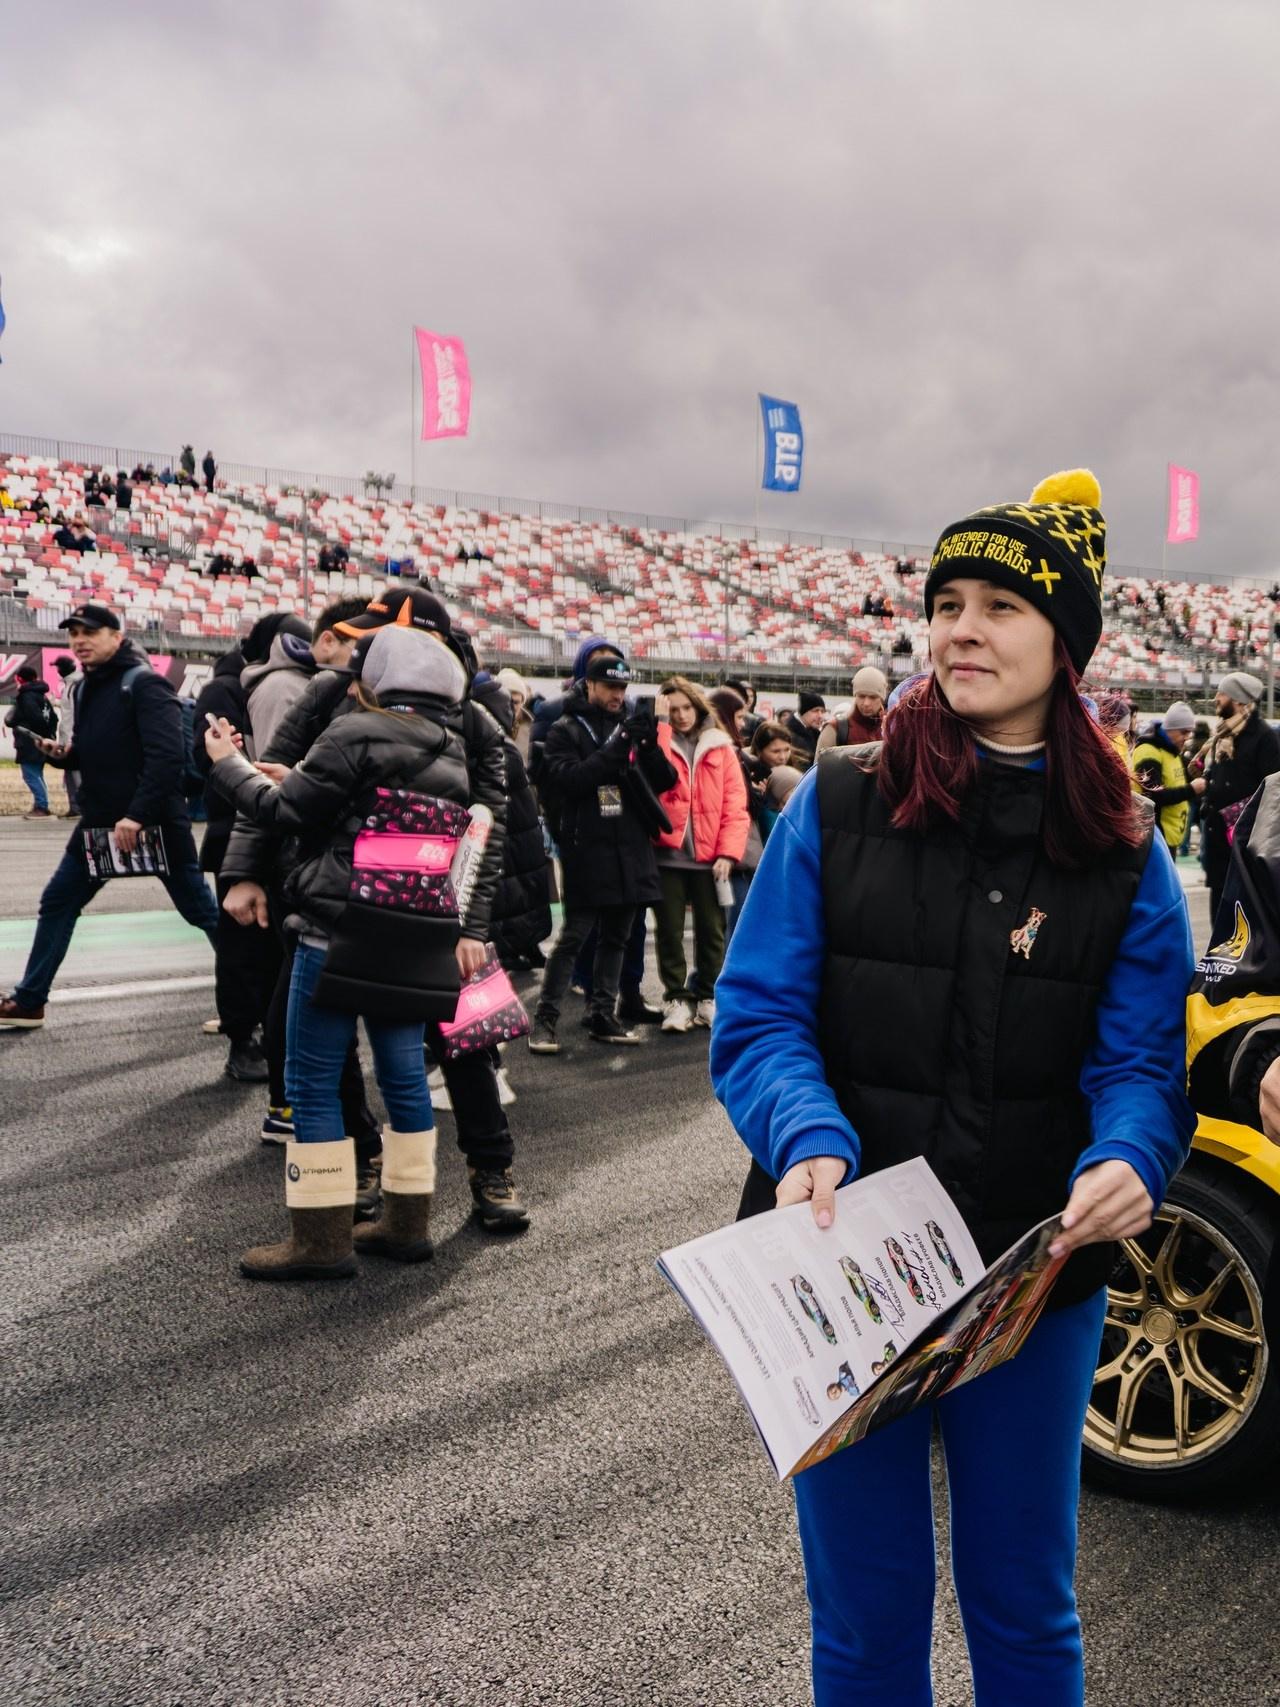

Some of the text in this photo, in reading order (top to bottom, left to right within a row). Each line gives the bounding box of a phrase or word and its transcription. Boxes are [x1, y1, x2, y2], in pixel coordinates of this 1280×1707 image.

[941, 540, 984, 562] PUBLIC
[984, 542, 1032, 575] ROADS
[951, 531, 989, 543] INTENDED
[989, 532, 1007, 545] FOR
[1008, 537, 1028, 556] USE
[913, 1232, 931, 1260] ЕРОФЕЕВ
[874, 1256, 907, 1317] ВЛАДИСЛАВ ПОПОВ
[927, 1260, 947, 1298] ВЛАДИСЛАВ
[839, 1295, 864, 1337] ИЛЬЯ ПОПОВ
[794, 1326, 816, 1359] АРКАДИЙ
